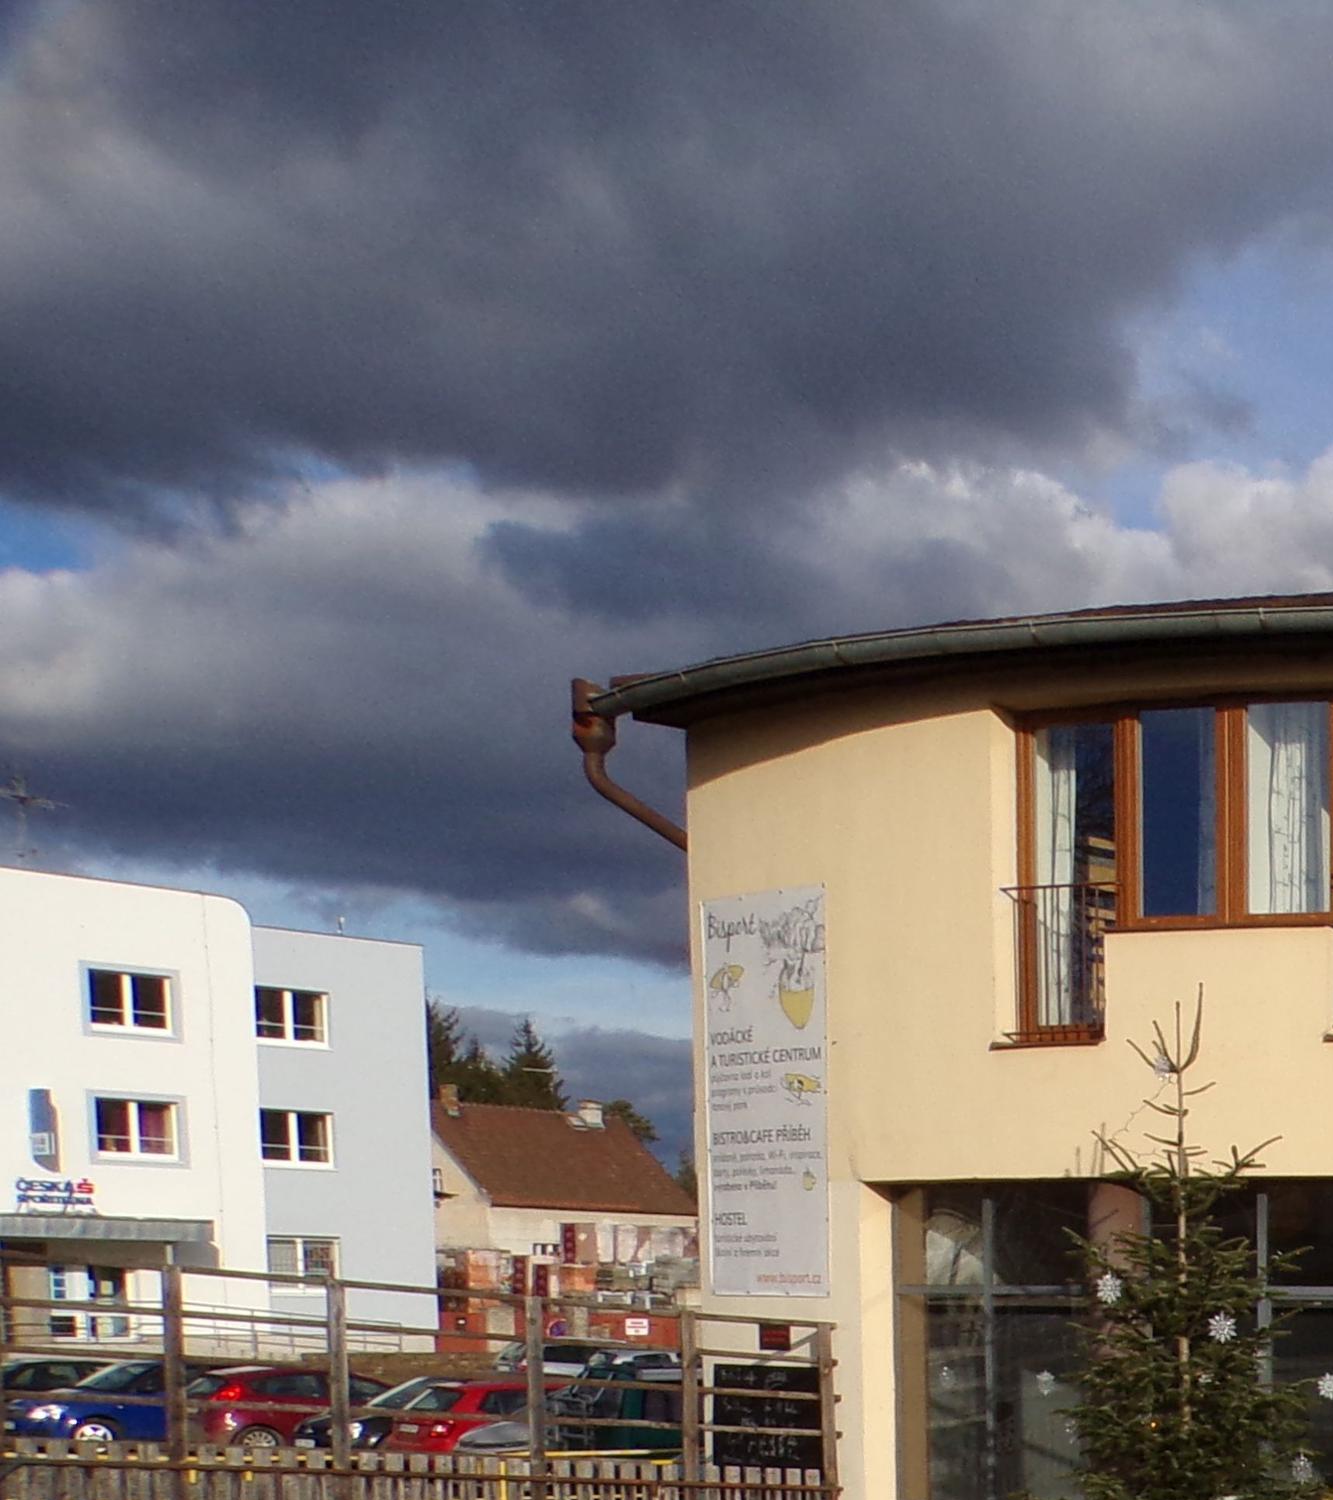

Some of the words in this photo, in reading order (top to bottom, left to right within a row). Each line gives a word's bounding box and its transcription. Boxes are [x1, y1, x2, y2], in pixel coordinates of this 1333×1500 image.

[720, 1047, 770, 1067] TURISTICKÉ
[773, 1046, 822, 1063] CENTRUM
[714, 1211, 748, 1226] HOSTEL
